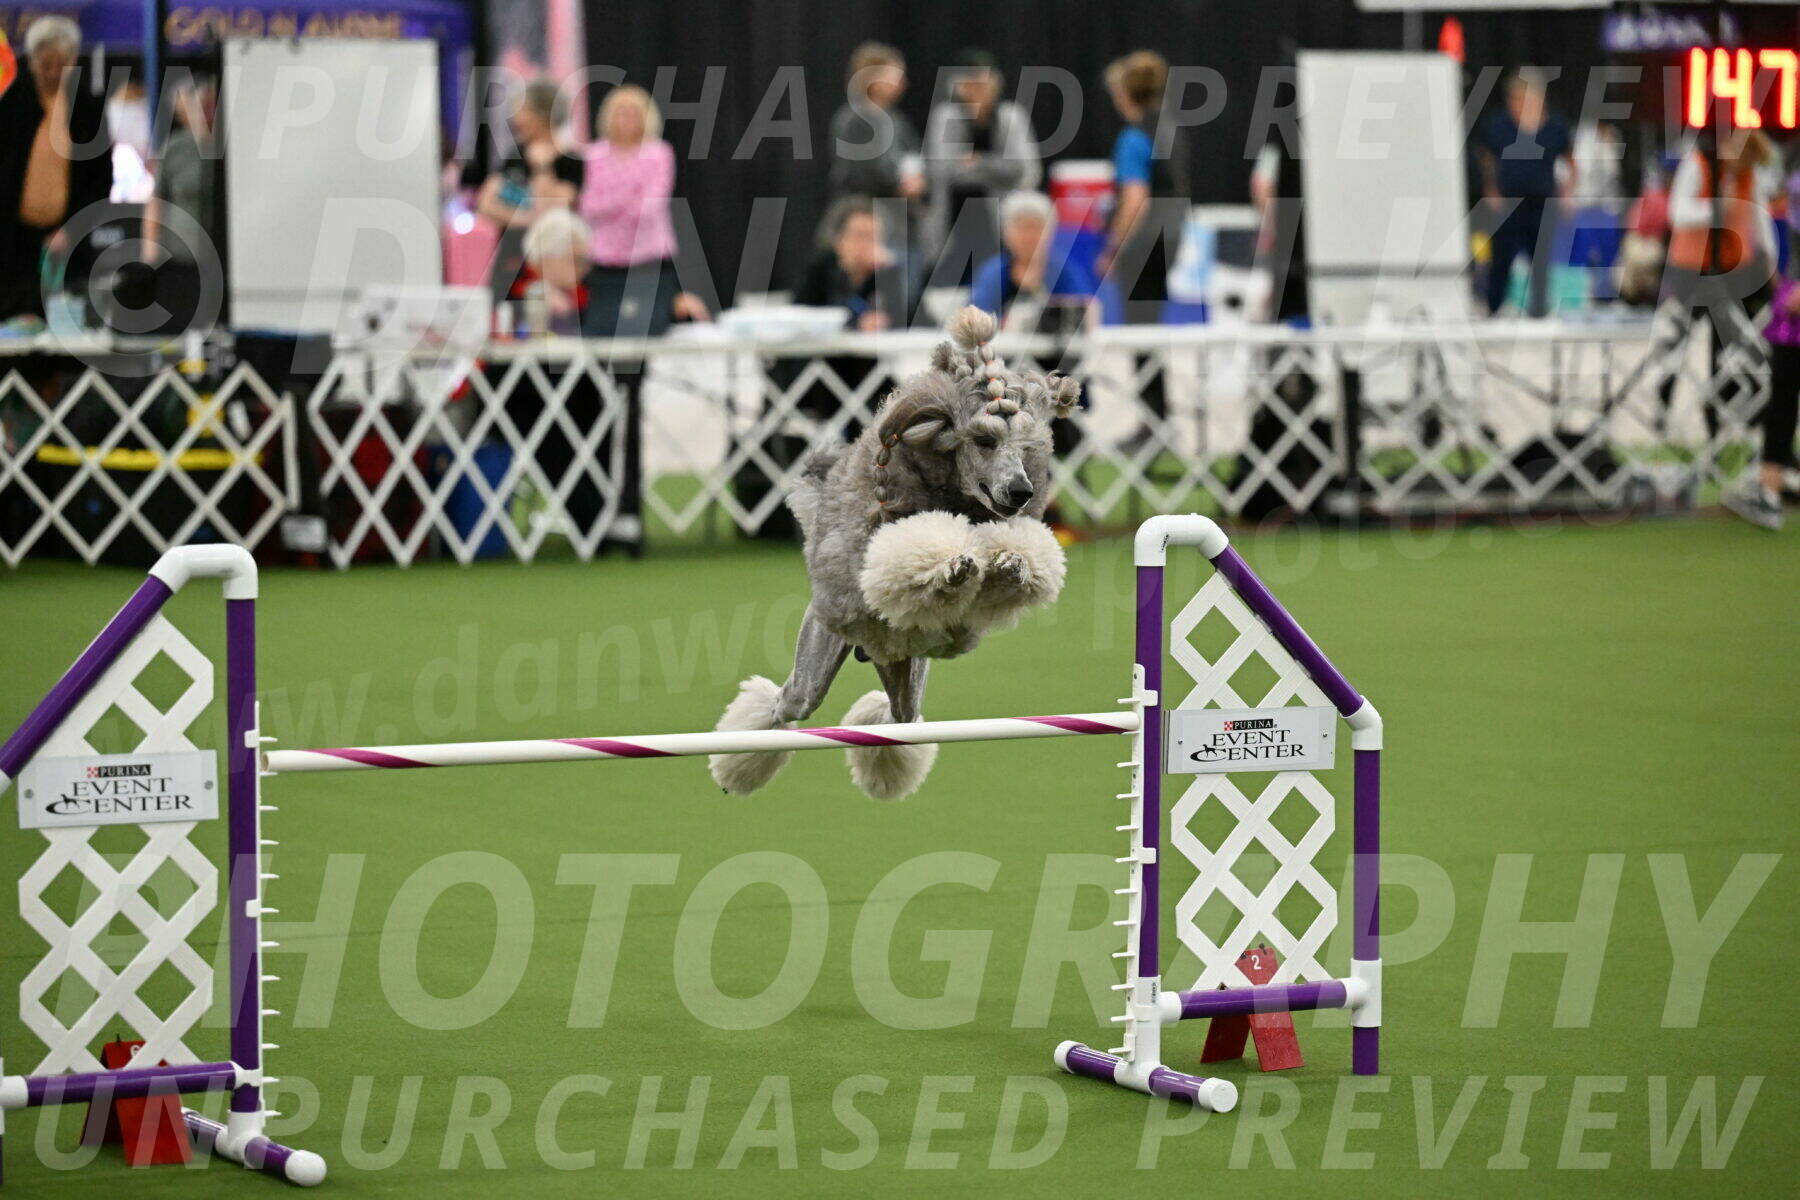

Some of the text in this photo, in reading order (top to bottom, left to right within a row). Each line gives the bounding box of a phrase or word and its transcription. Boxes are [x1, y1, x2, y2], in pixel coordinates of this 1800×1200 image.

[1235, 719, 1272, 729] PURINA
[1211, 729, 1290, 746] EVENT
[1190, 743, 1306, 762] CENTER
[100, 765, 150, 777] PURINA
[72, 777, 173, 797] EVENT
[45, 794, 193, 815] CENTER
[1251, 955, 1262, 970] 2
